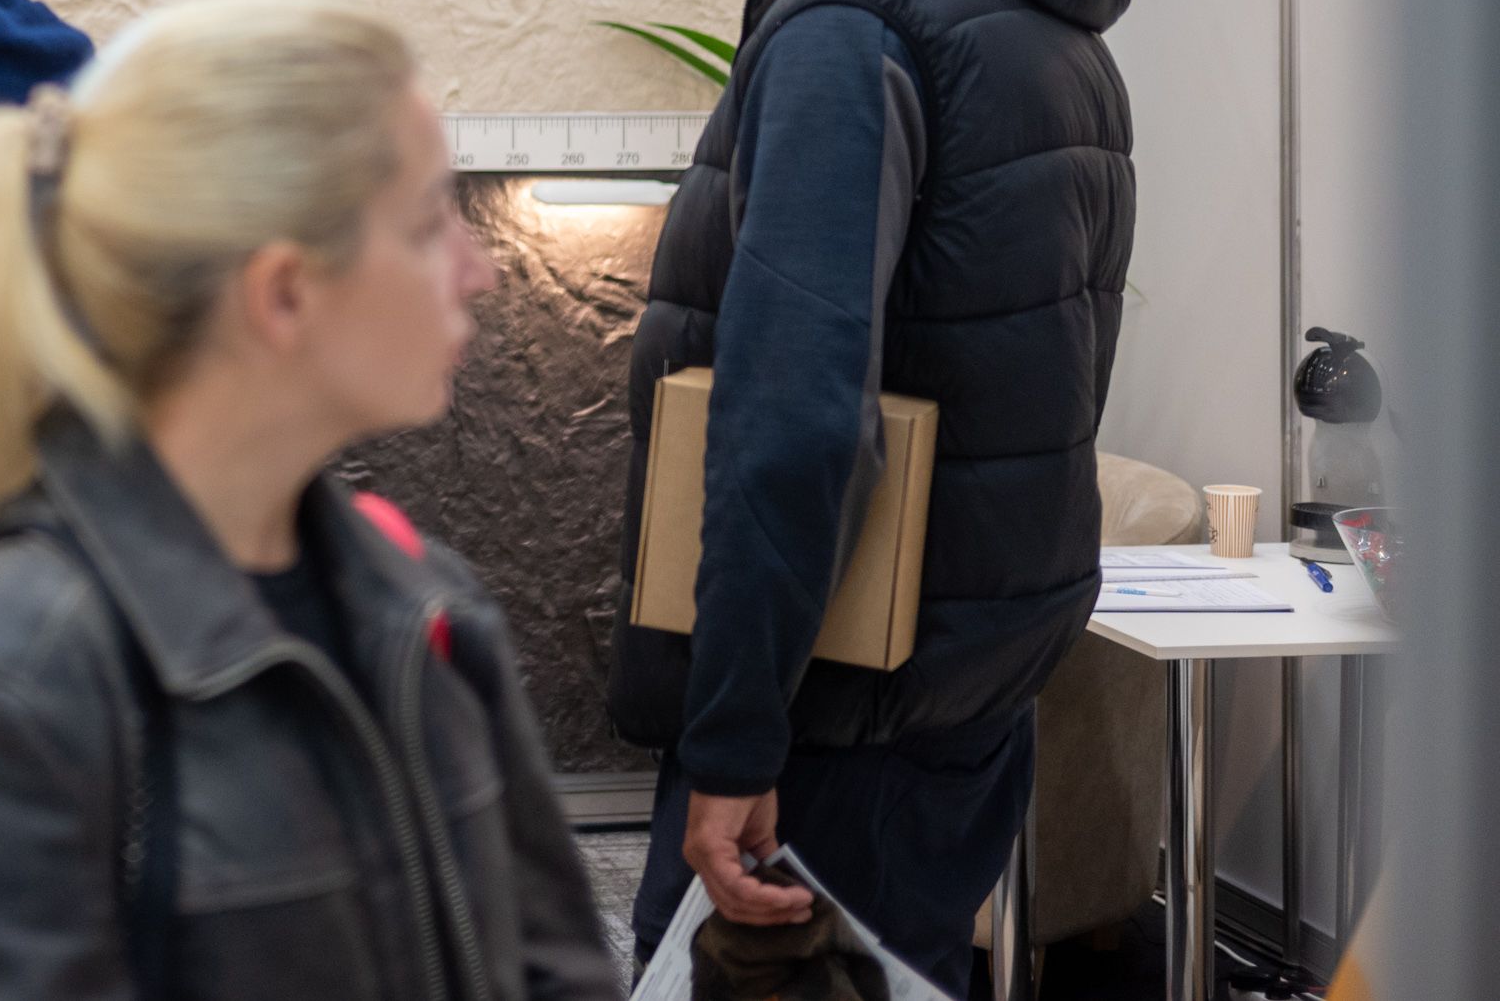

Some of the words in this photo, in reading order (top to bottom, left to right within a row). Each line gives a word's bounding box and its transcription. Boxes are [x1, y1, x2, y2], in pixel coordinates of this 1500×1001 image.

[506, 153, 529, 166] 250
[561, 152, 584, 166] 260
[616, 152, 640, 165] 270
[671, 151, 694, 165] 280
